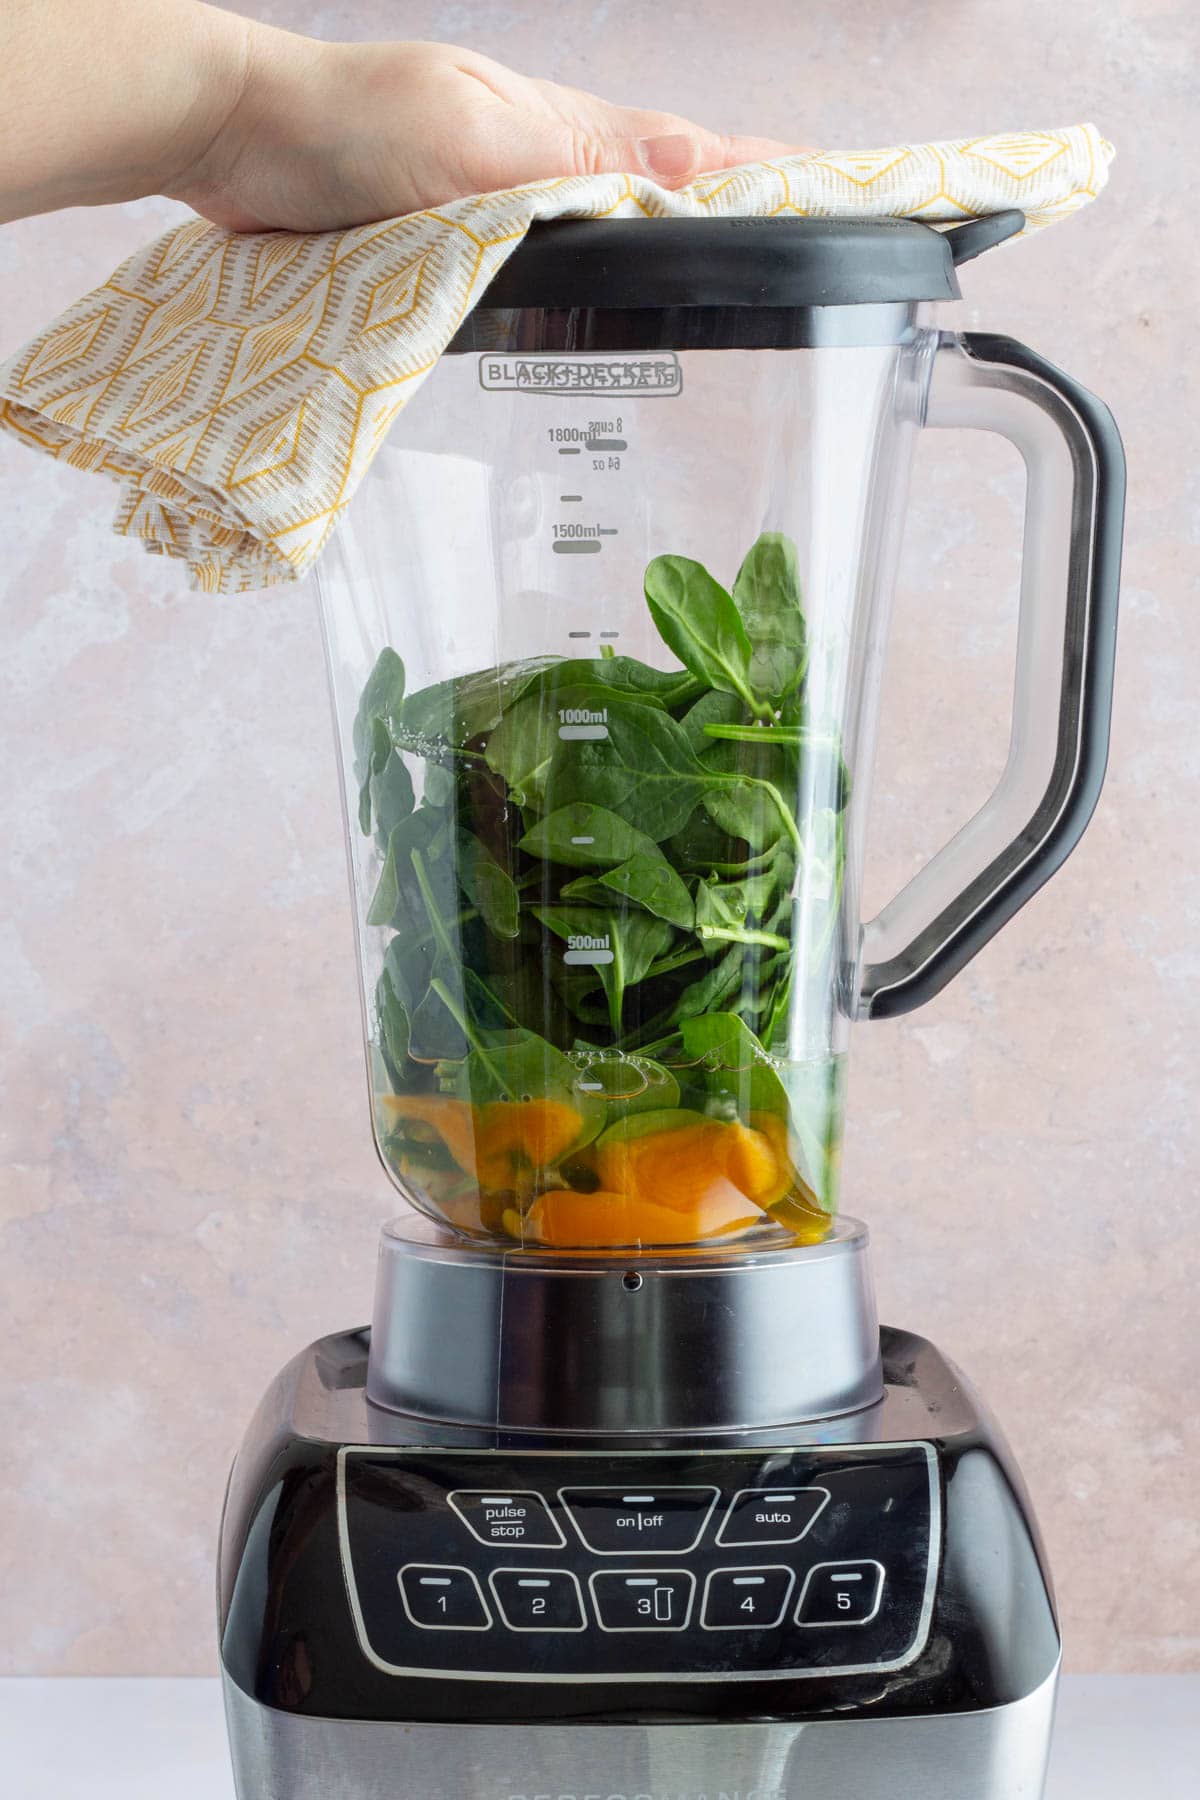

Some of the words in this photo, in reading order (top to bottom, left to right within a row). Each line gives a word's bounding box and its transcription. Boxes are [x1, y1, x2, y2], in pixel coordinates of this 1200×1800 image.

[551, 523, 600, 538] 1500ml
[558, 708, 608, 723] 1000ml
[567, 934, 609, 949] 500ml
[485, 1506, 527, 1520] pulse
[755, 1511, 791, 1524] auto
[490, 1525, 525, 1538] stop
[438, 1597, 446, 1612] 1
[532, 1599, 546, 1614] 2
[637, 1599, 651, 1614] 3
[740, 1597, 756, 1612] 4
[836, 1593, 850, 1609] 5
